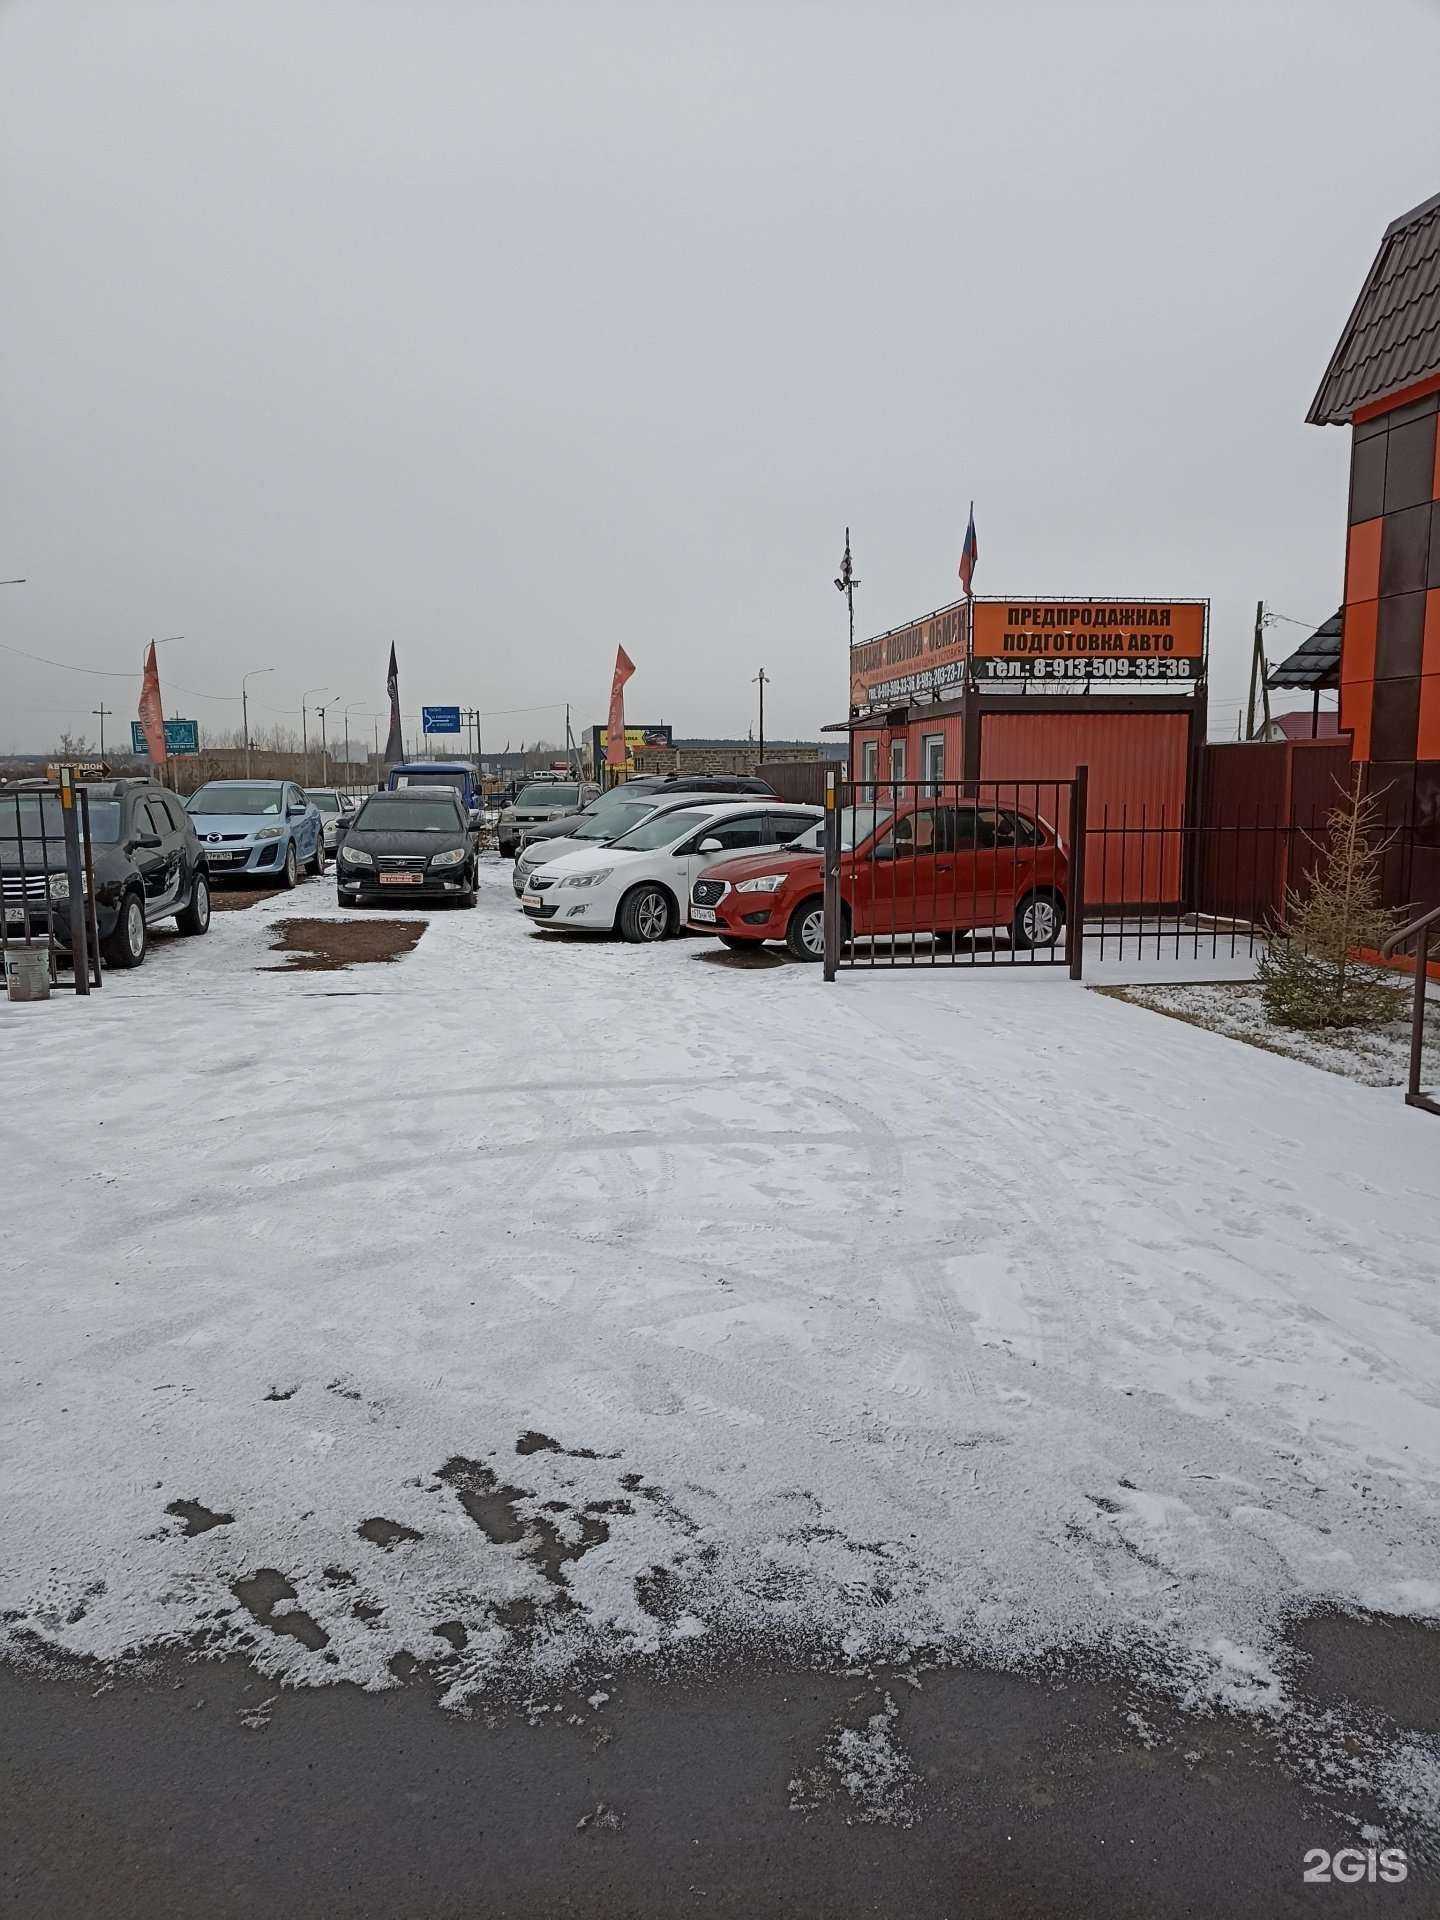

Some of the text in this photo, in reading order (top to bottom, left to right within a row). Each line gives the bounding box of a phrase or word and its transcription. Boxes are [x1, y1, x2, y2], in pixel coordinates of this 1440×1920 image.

[1008, 607, 1171, 628] ПРЕДПРОДАЖНАЯ
[929, 608, 966, 652] ОБМЕН
[1003, 633, 1174, 654] ПОДГОТОВКА АВТО
[986, 660, 1030, 677] тел.:
[1033, 658, 1190, 677] 8-913-509-33-36
